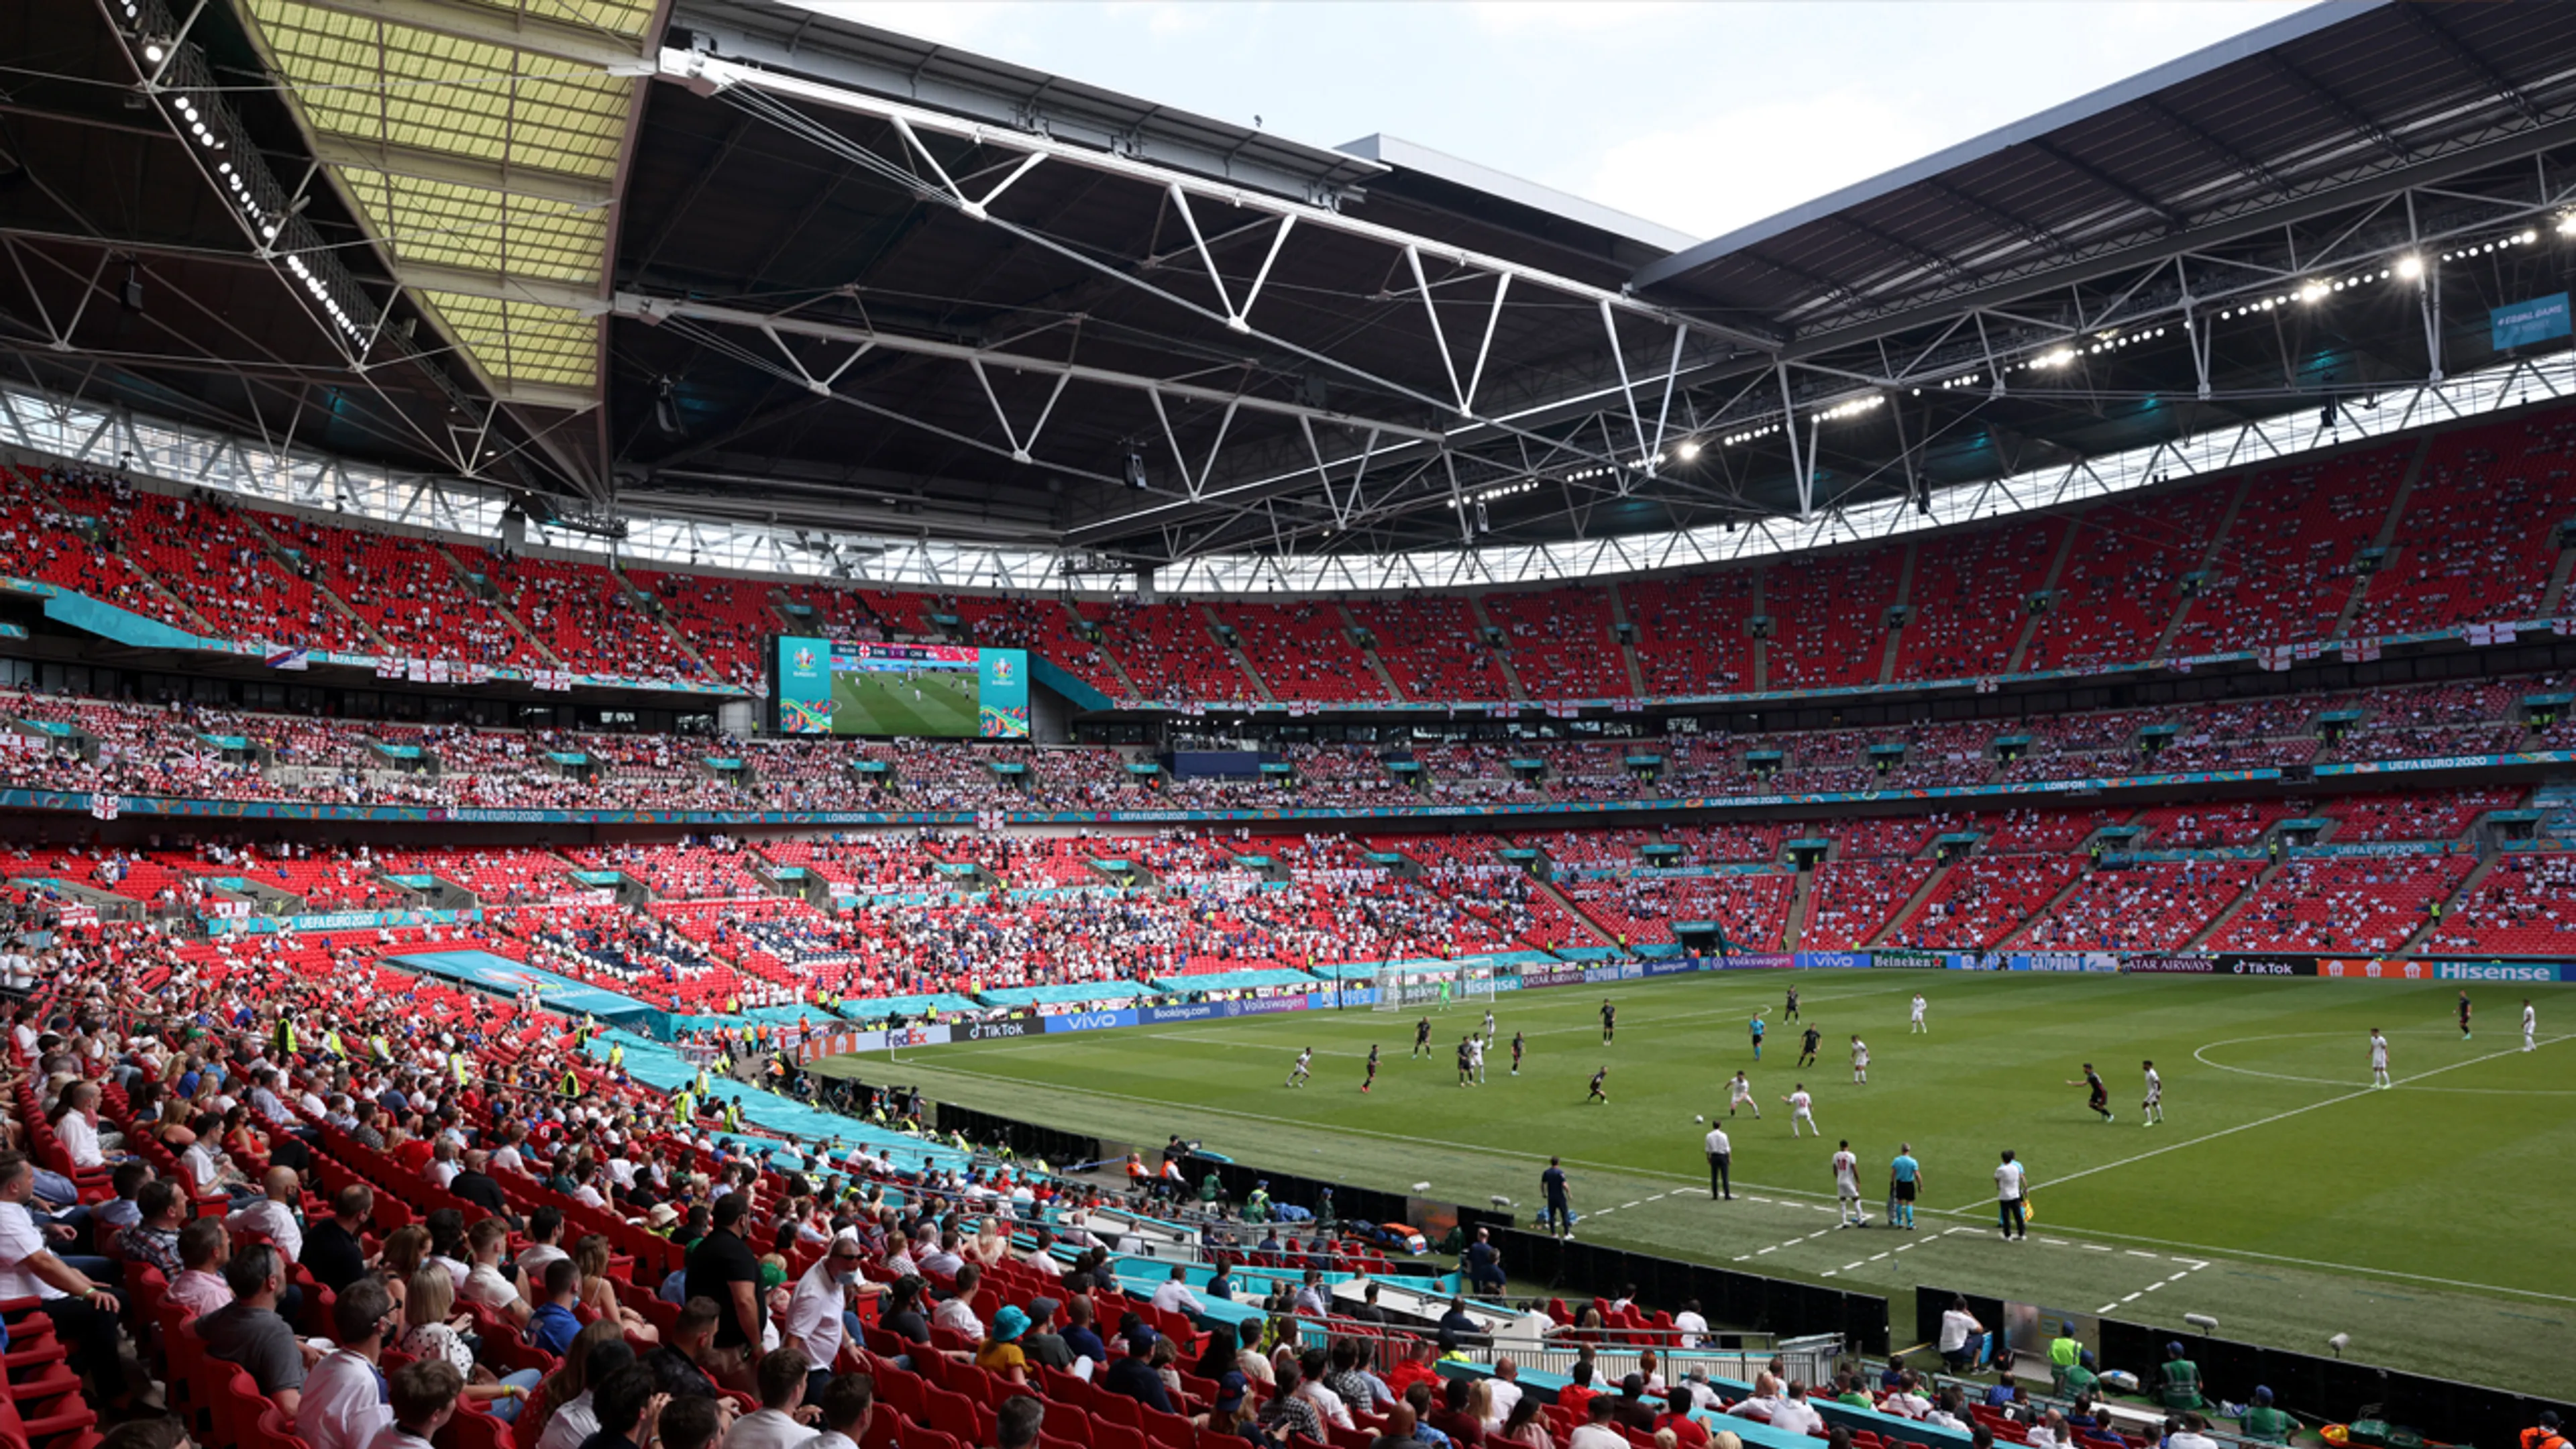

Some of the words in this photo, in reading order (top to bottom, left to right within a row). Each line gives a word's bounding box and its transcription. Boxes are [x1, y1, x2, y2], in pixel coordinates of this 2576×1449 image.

[2387, 761, 2421, 771] UEFA
[2421, 759, 2454, 769] EURO
[2455, 757, 2487, 767] 2020
[487, 810, 516, 821] EURO
[517, 810, 545, 822] 2020
[825, 812, 867, 823] LONDON
[1118, 812, 1142, 821] UEFA
[1143, 811, 1166, 820] EURO
[1167, 810, 1189, 820] 2020
[299, 916, 325, 928] UEFA
[326, 914, 351, 927] EURO
[352, 913, 375, 926] 2020
[1727, 955, 1792, 967] Volkswagen
[1874, 955, 1931, 967] Heineken
[2030, 956, 2080, 971] GAZPROM
[2129, 960, 2160, 971] ATAR
[2161, 960, 2213, 971] AIRWAYS
[2249, 962, 2293, 975] TikTok
[2440, 962, 2550, 981] Hisense
[1244, 996, 1305, 1012] Volkswagen
[1153, 1006, 1211, 1020] Booking.com
[983, 1022, 1024, 1038] TikTok
[885, 1028, 928, 1048] FedEx
